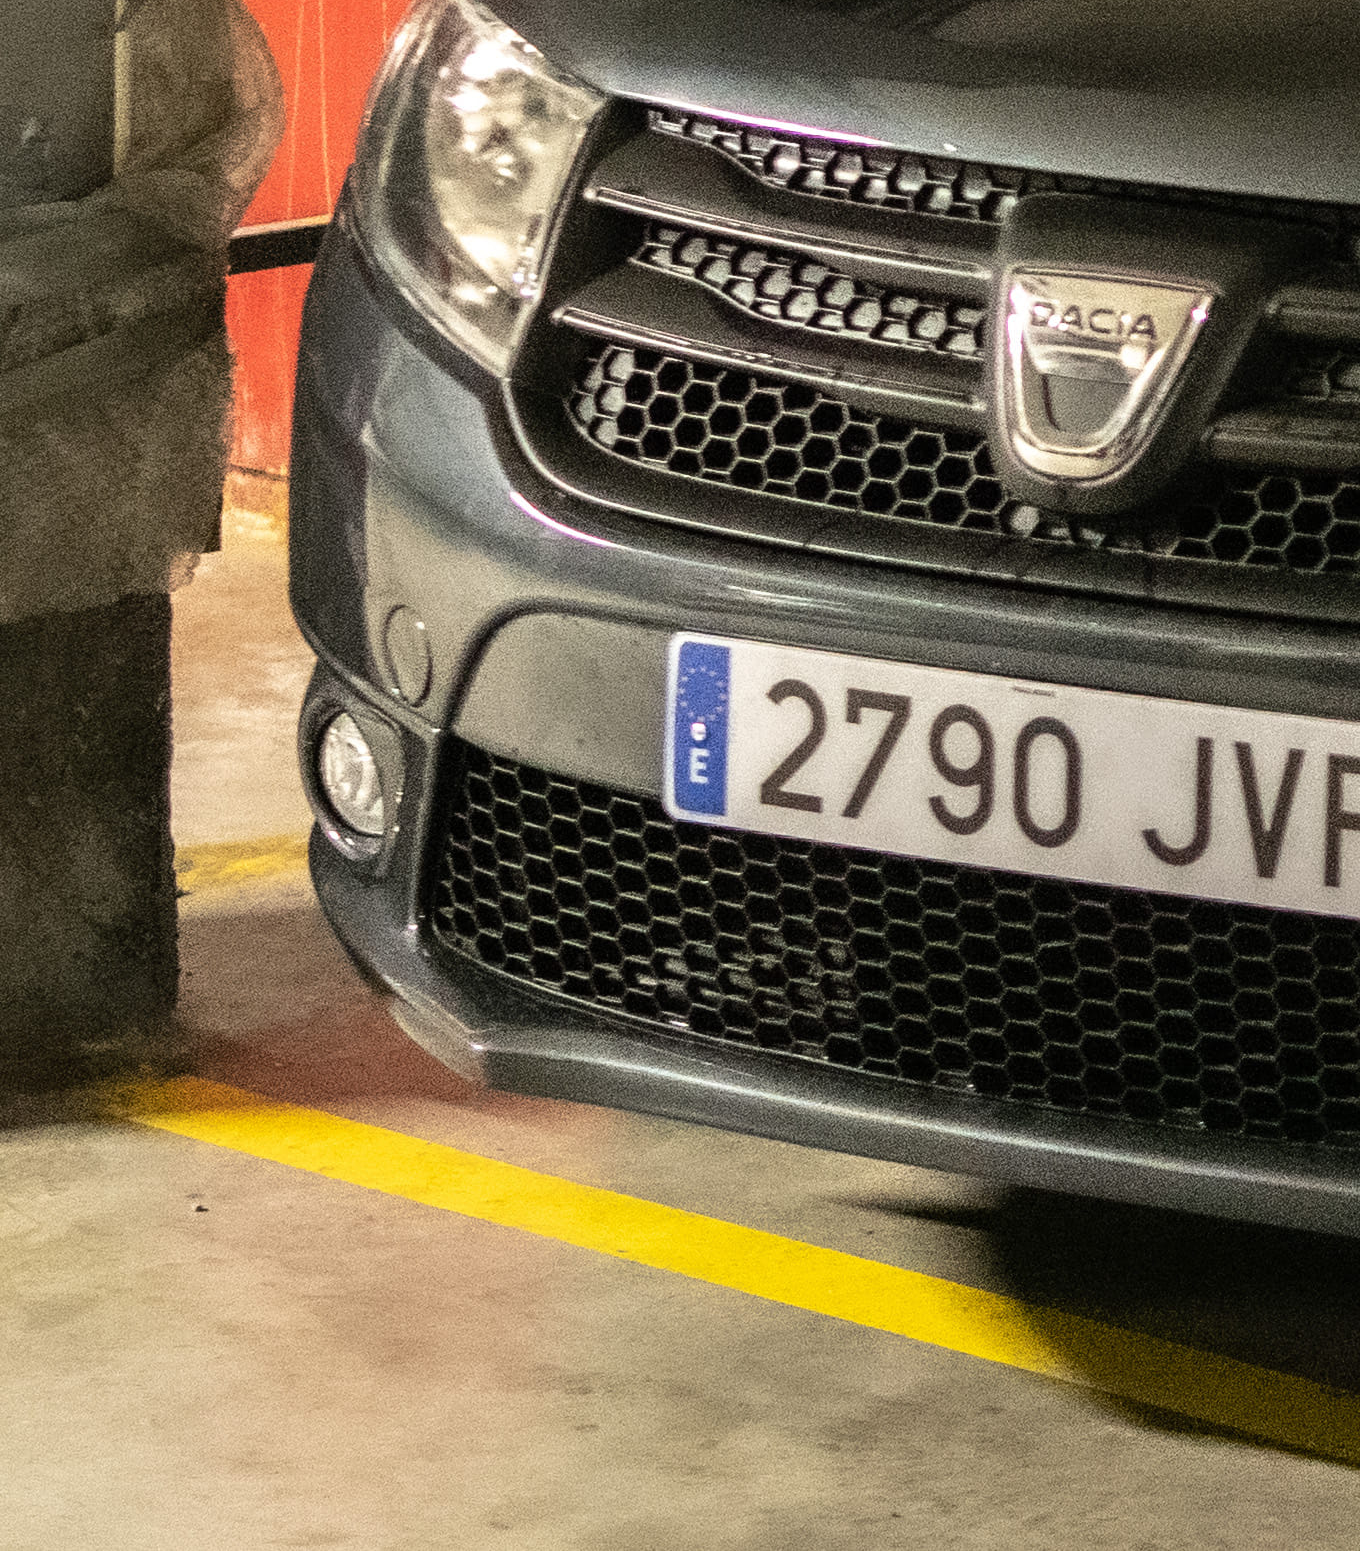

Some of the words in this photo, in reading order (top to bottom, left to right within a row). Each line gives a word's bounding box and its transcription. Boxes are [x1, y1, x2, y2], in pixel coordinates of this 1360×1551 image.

[1030, 302, 1157, 340] DACIA
[689, 747, 709, 785] E
[759, 678, 1083, 849] 2790
